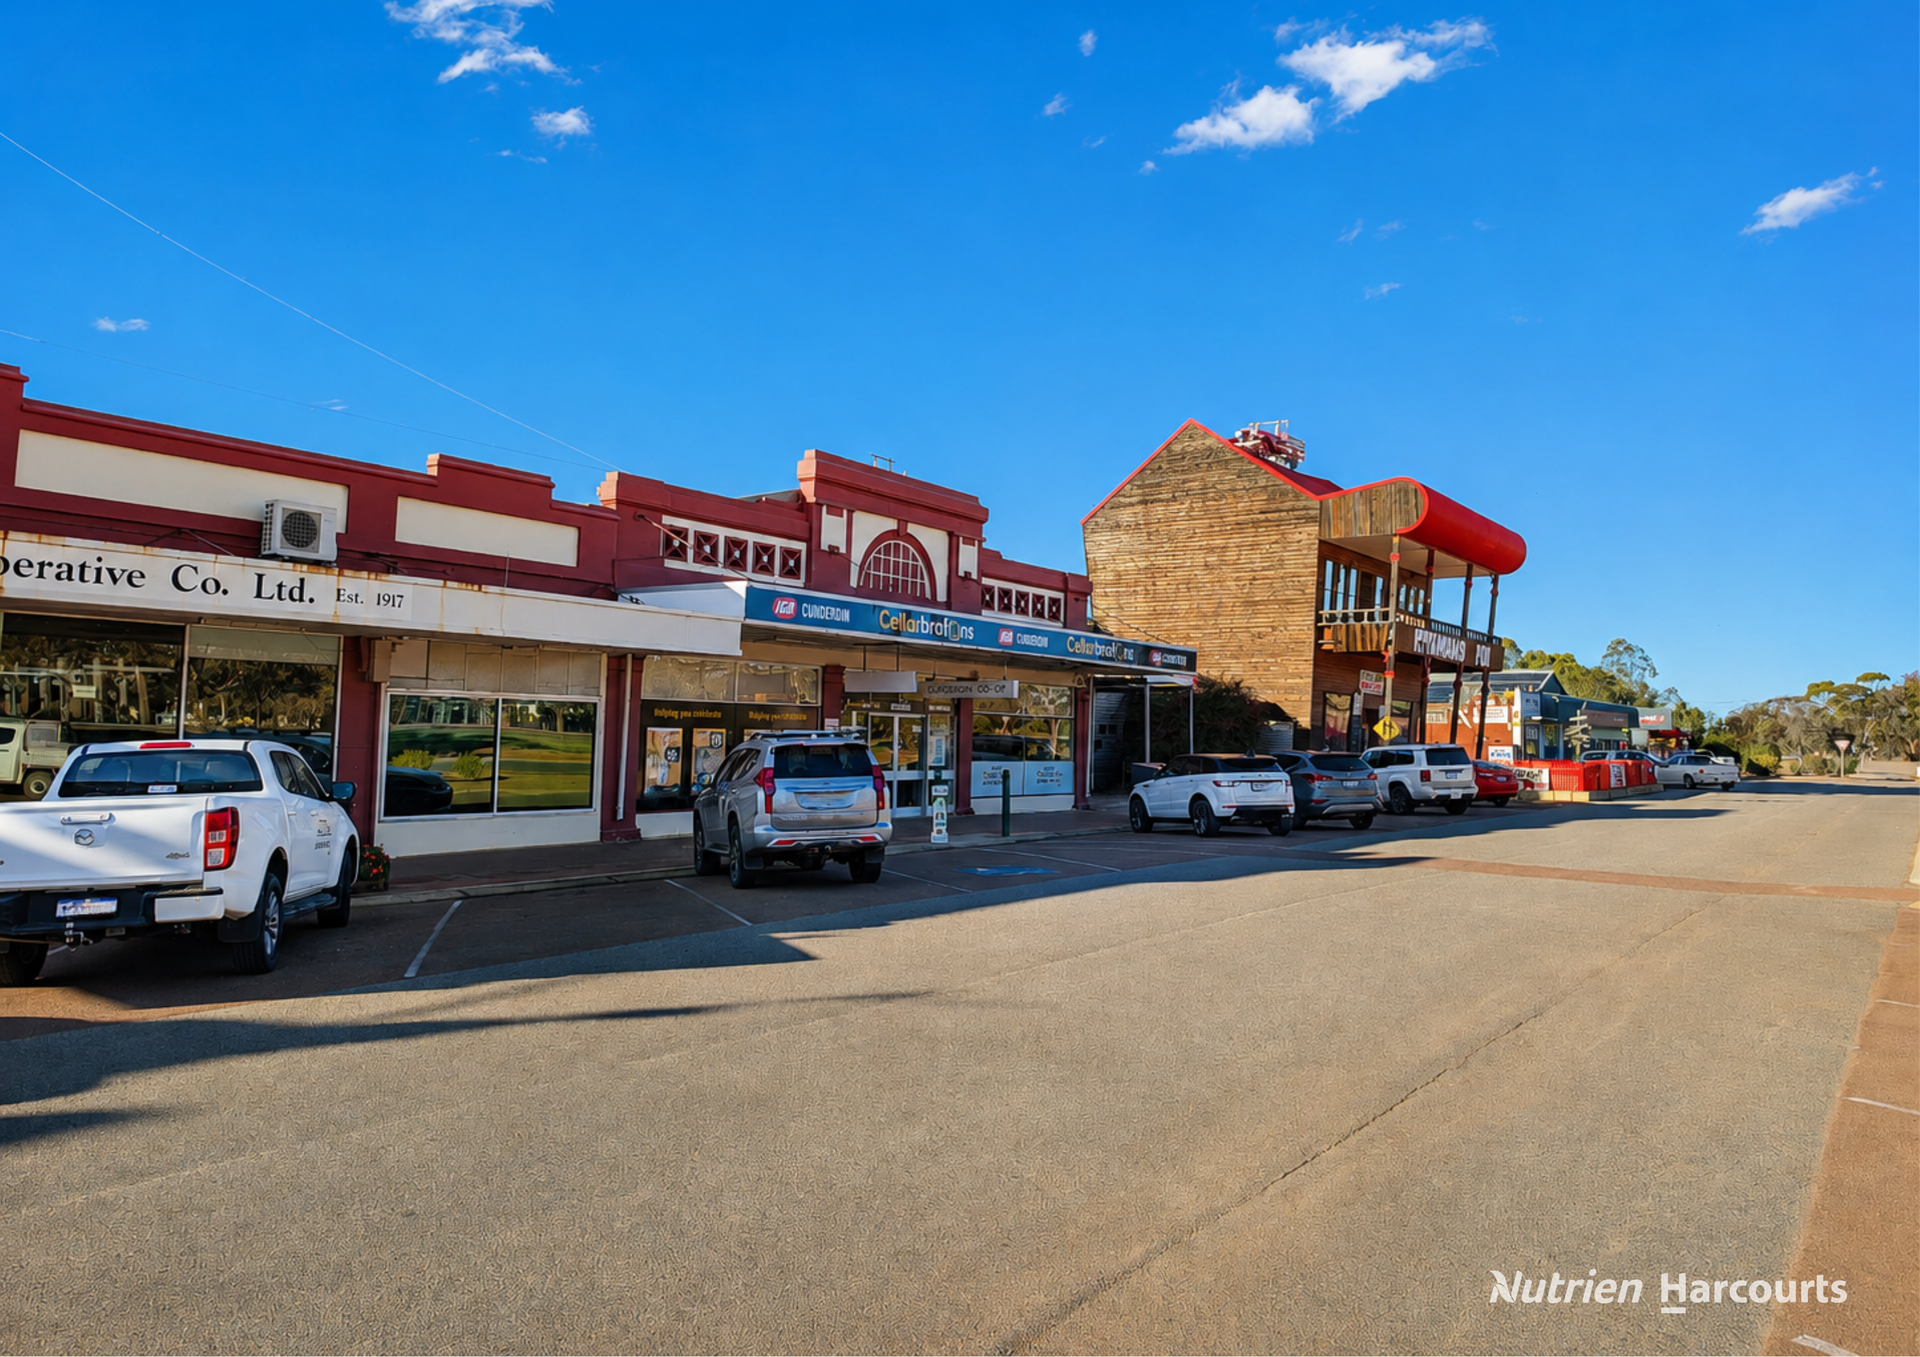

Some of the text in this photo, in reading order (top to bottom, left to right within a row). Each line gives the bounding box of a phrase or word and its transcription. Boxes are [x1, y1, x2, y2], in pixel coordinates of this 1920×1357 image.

[171, 564, 230, 596] Co.
[254, 573, 315, 603] Ltd.
[336, 587, 364, 605] Est.
[376, 592, 404, 608] 1917
